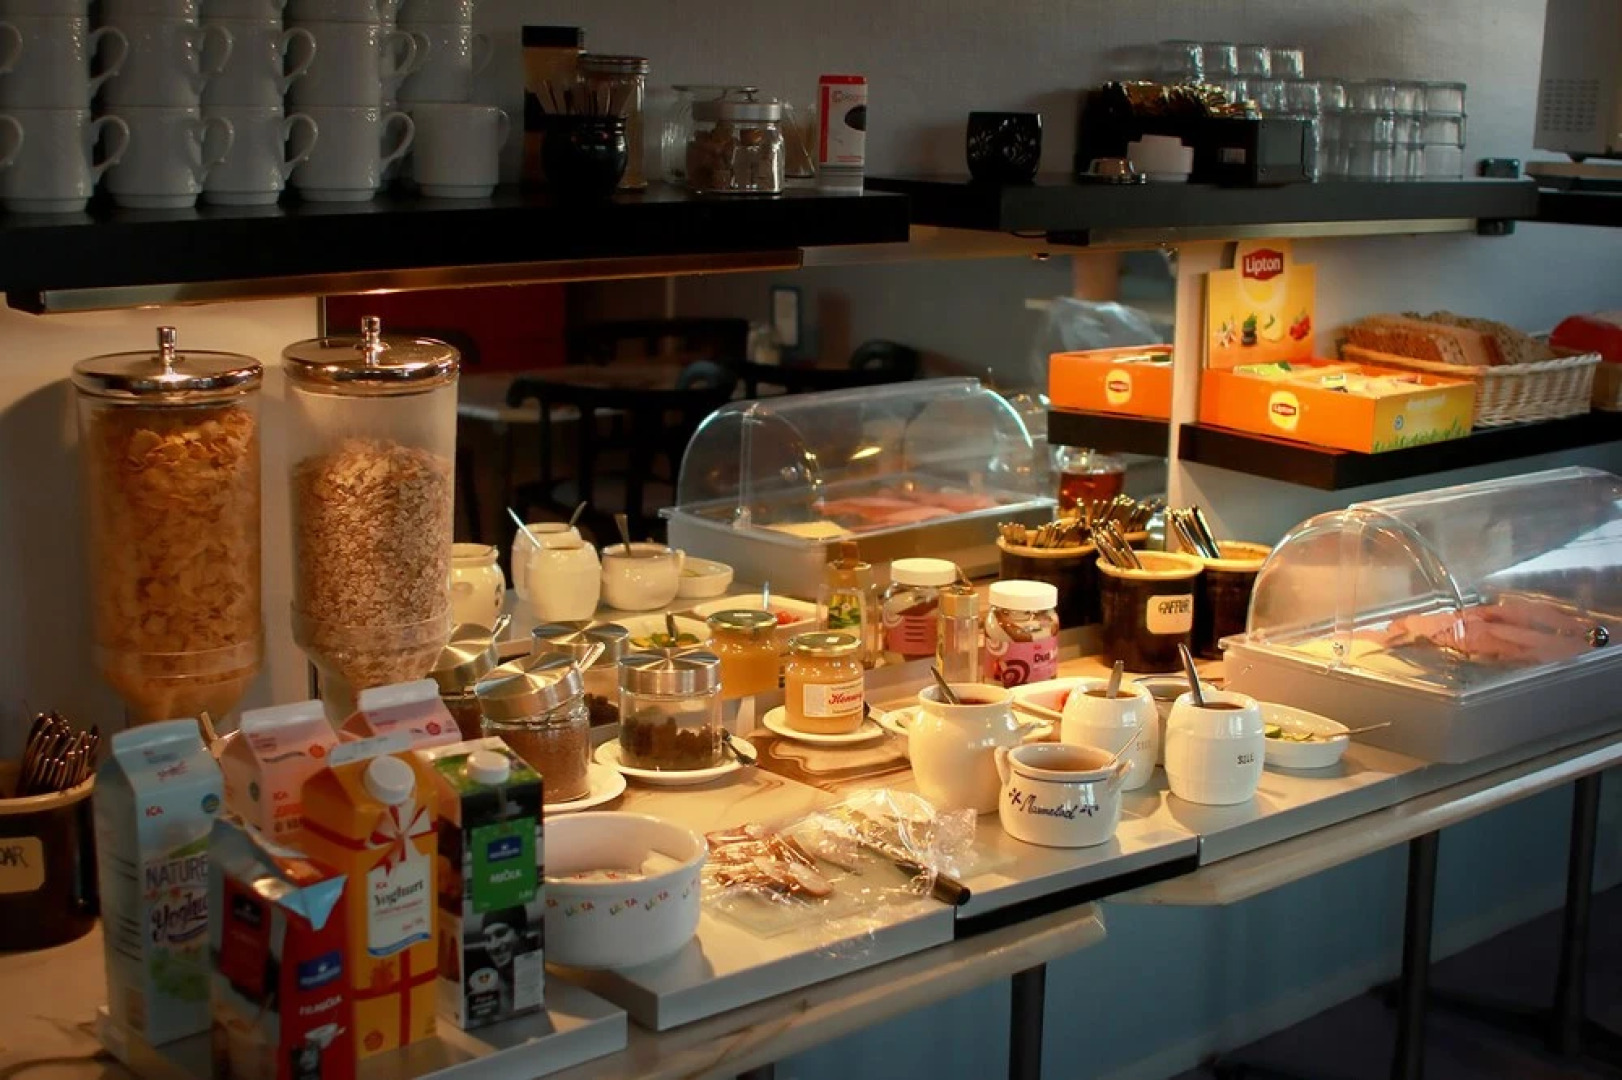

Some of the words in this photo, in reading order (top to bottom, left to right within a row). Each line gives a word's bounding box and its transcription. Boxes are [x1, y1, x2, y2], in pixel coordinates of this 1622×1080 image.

[1246, 256, 1281, 276] Lipton
[145, 805, 164, 818] ICA
[374, 879, 424, 906] Yoghurt
